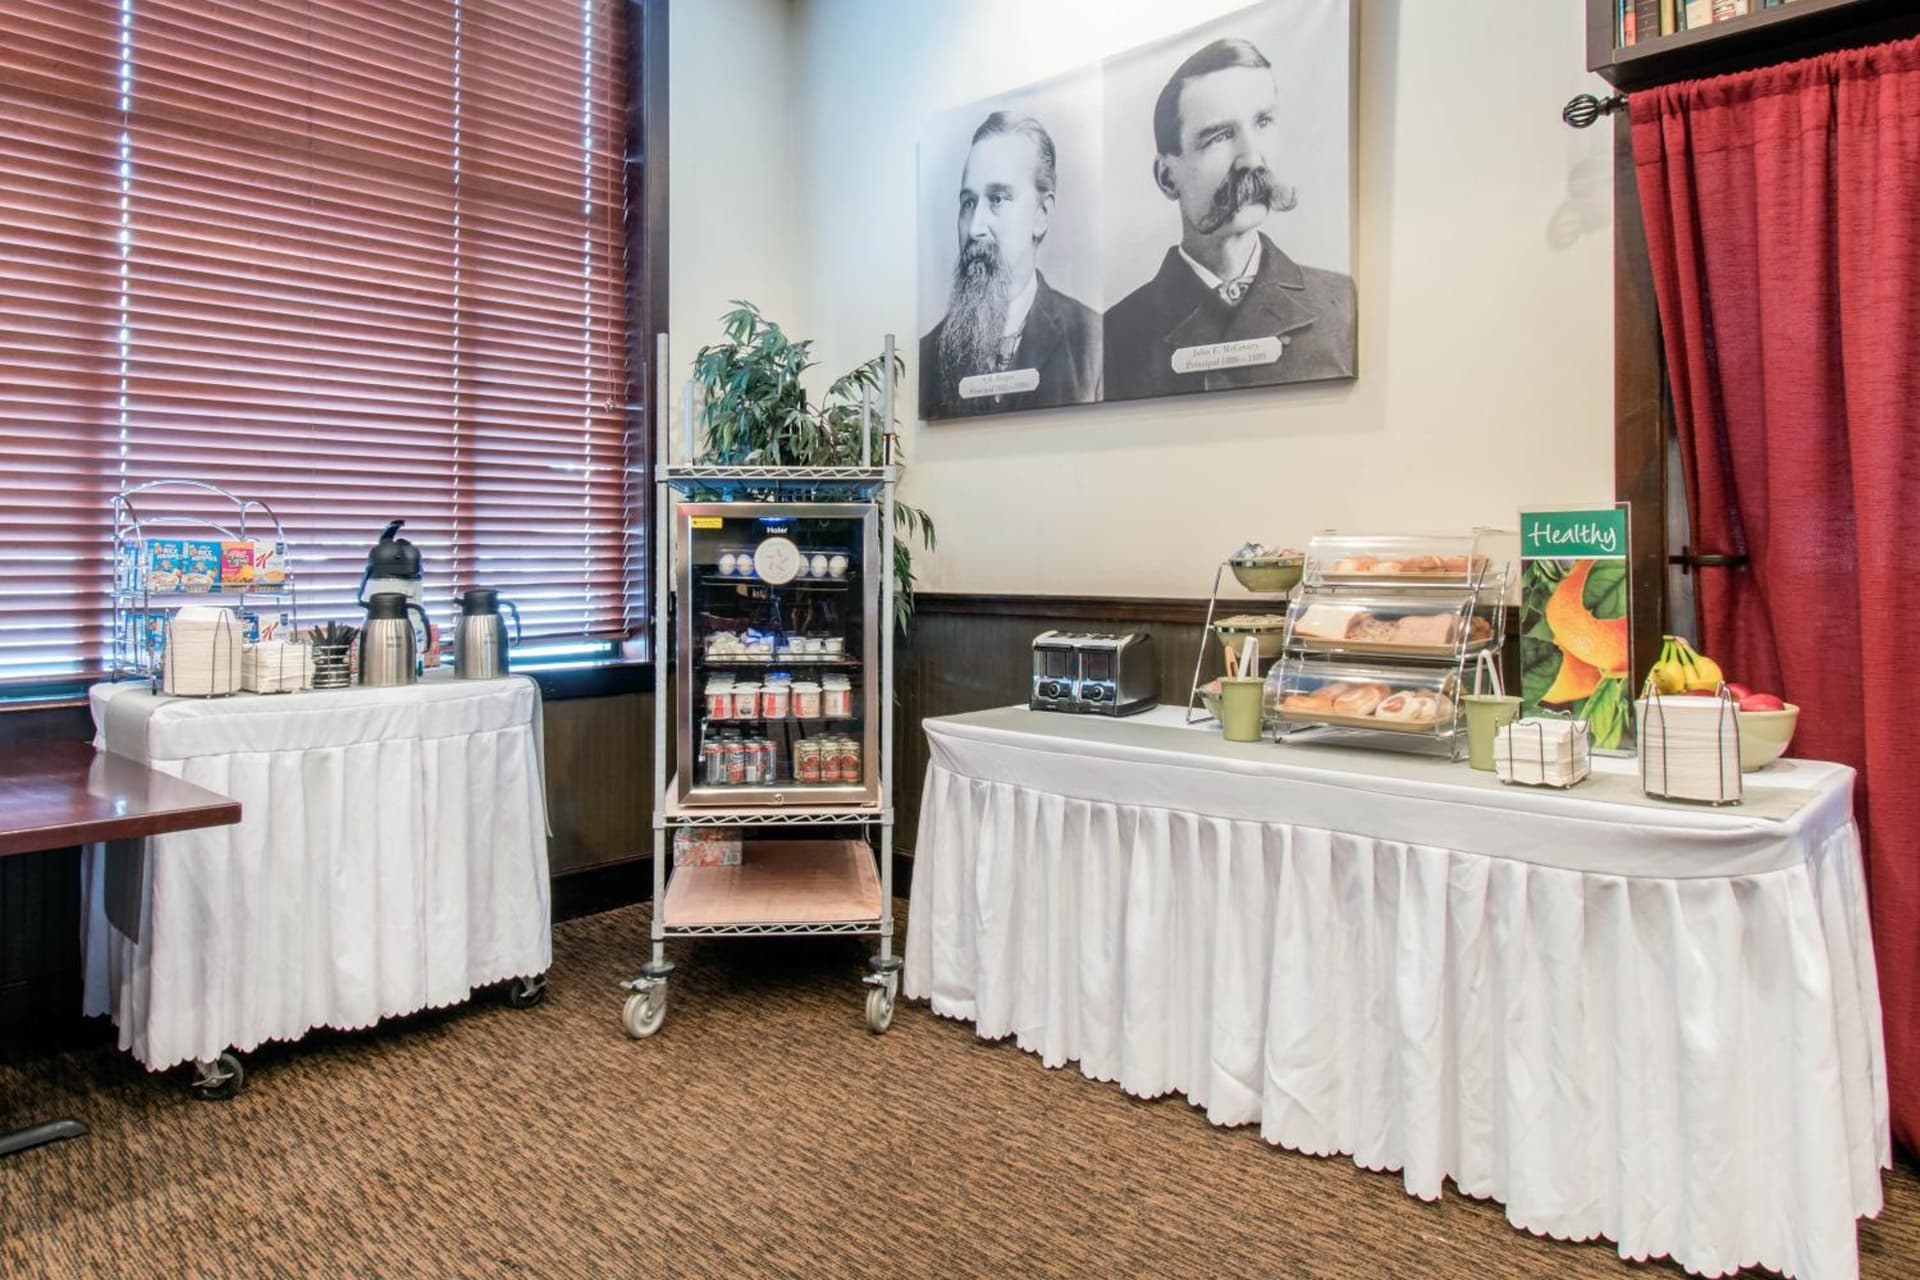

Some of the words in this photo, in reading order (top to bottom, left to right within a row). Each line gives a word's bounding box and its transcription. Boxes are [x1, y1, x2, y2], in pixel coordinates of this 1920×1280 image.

[1193, 348, 1210, 357] John
[766, 526, 788, 534] Haier
[1527, 521, 1616, 552] Healthy
[256, 550, 273, 568] K
